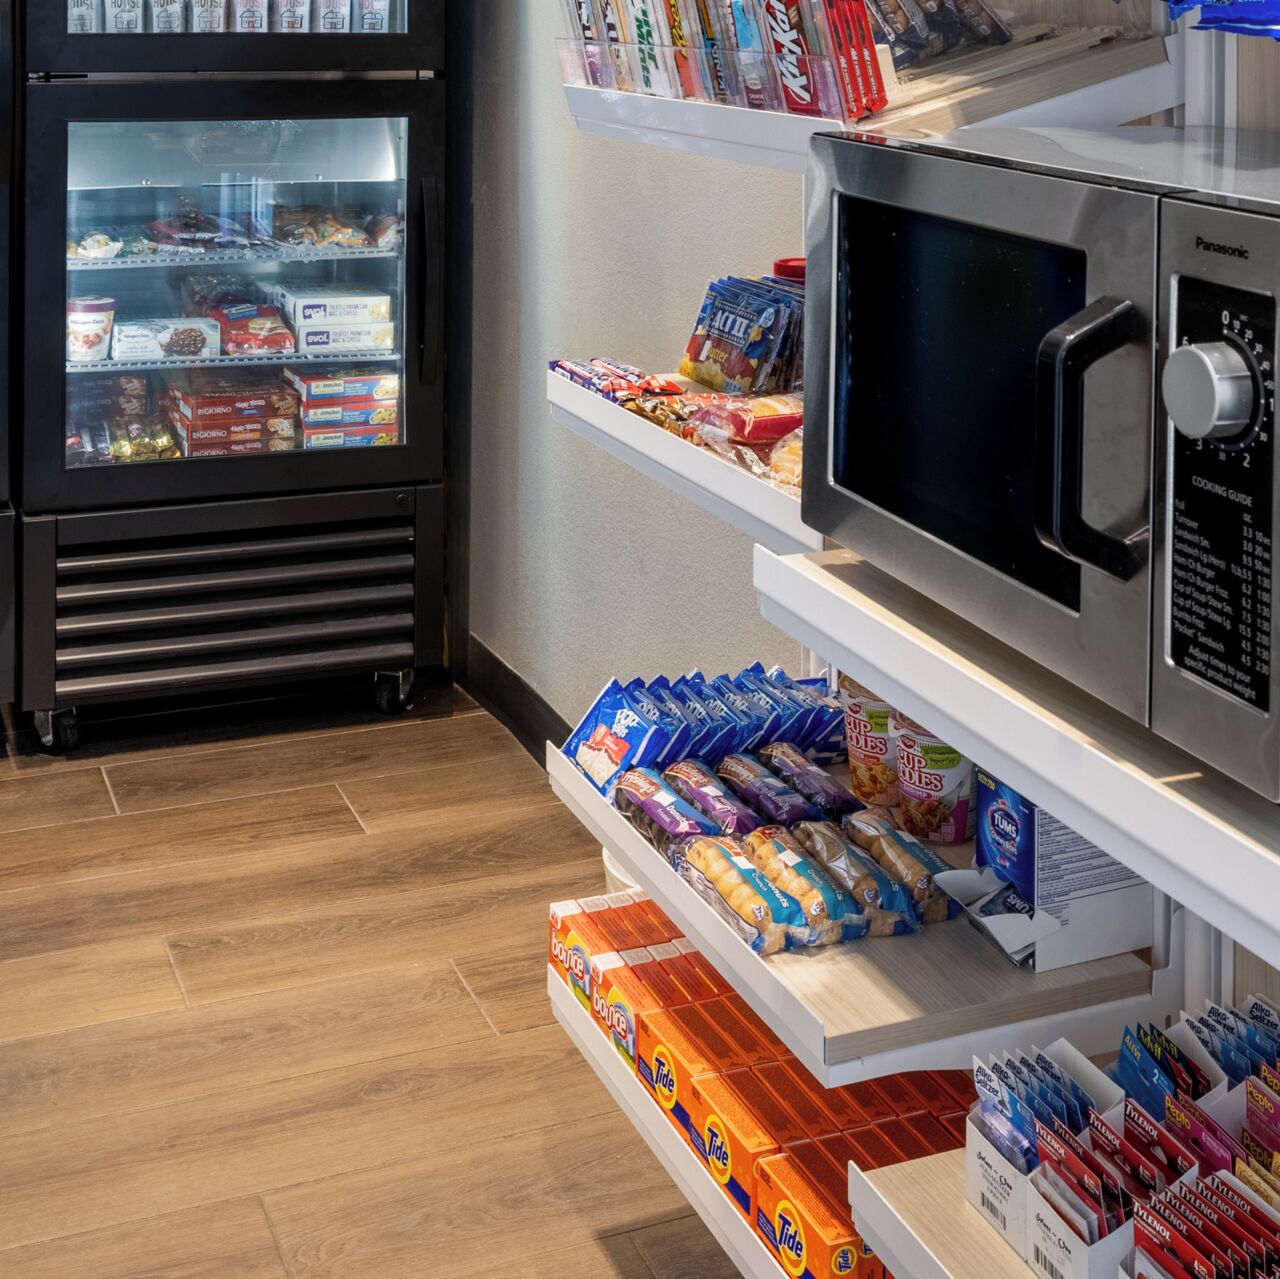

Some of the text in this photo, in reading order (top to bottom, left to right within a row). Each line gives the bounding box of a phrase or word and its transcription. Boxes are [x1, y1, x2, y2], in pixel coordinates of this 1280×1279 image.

[1195, 236, 1249, 259] Panasonic
[1222, 310, 1229, 325] 0
[1192, 475, 1253, 508] COOKING GUIDE
[1174, 525, 1200, 544] Sandwich
[1175, 511, 1199, 529] Turnover
[1174, 539, 1200, 557] Sandwich
[1196, 562, 1216, 579] Burger
[1196, 576, 1215, 592] Burger
[1173, 606, 1192, 623] Burrito
[1197, 632, 1225, 653] Sandwich
[1184, 656, 1256, 700] specific product weight
[1188, 645, 1209, 662] Adjust
[1209, 655, 1227, 672] times
[1236, 670, 1252, 683] your
[994, 813, 1017, 838] TUMS
[551, 935, 587, 981] bounce
[593, 991, 628, 1040] bounce
[1249, 1010, 1280, 1032] Seltzer
[652, 1057, 676, 1097] Tide
[975, 1073, 1000, 1098] Seltzer
[976, 1065, 994, 1083] Alka-
[1152, 1068, 1159, 1083] 2
[1165, 1096, 1192, 1129] Pepto
[1247, 1080, 1274, 1114] Pepto
[1035, 1120, 1066, 1156] TYLENOL
[1052, 1120, 1084, 1156] TYLENOL
[1089, 1113, 1120, 1149] TYLENOL
[1126, 1103, 1158, 1139] TYLENOL
[705, 1127, 730, 1173] Tide
[1166, 1189, 1204, 1230] TYLENOL
[1180, 1183, 1219, 1225] TYLENOL
[1196, 1180, 1236, 1220] TYLENOL
[1212, 1176, 1252, 1216] TYLENOL
[1133, 1200, 1172, 1241] TYLENOL
[1150, 1193, 1188, 1235] TYLENOL
[778, 1211, 805, 1262] Tide
[835, 1248, 852, 1273] Tide
